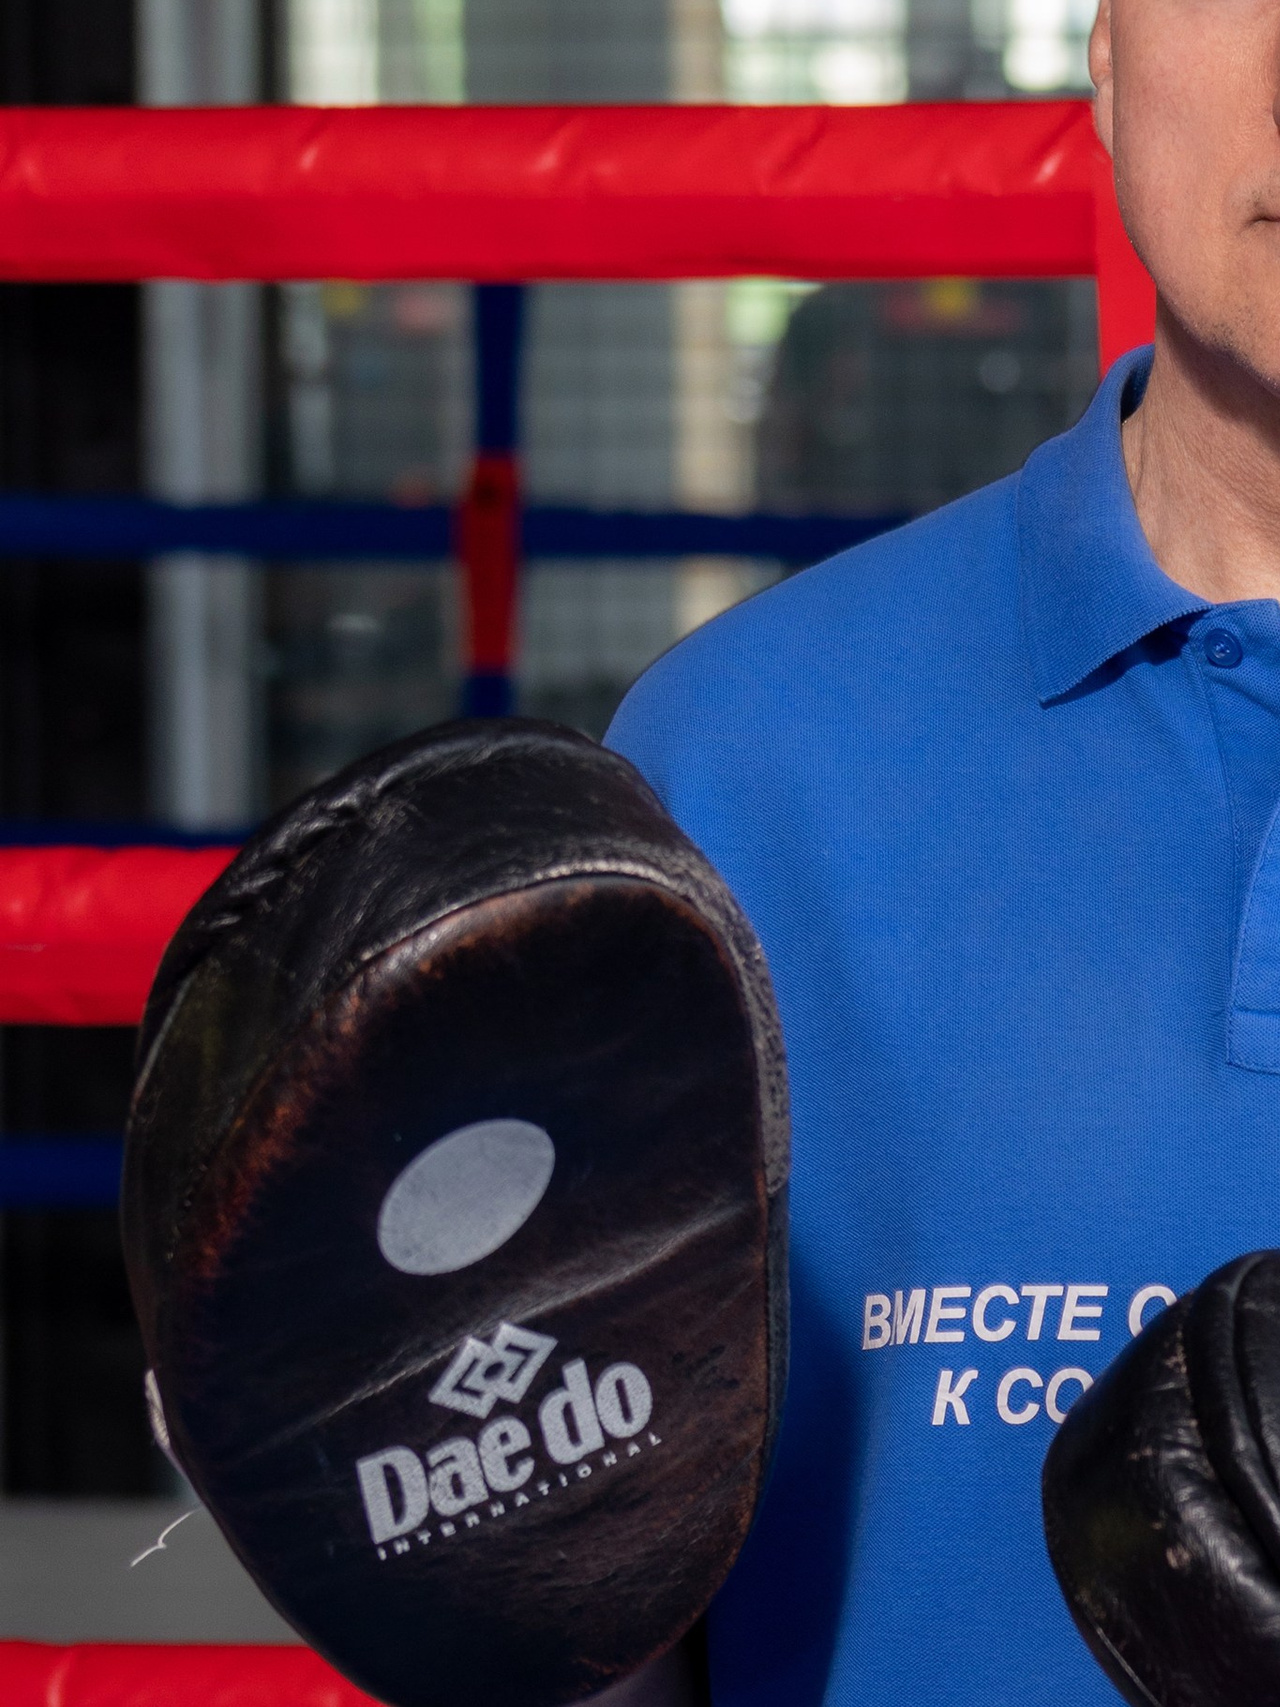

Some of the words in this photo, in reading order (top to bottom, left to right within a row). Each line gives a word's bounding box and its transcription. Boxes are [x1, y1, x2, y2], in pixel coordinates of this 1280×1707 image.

[861, 1283, 1109, 1350] ВМЕСТЕ
[931, 1369, 979, 1426] К
[996, 1367, 1095, 1425] СО
[377, 1431, 663, 1561] INTERNATIONAL
